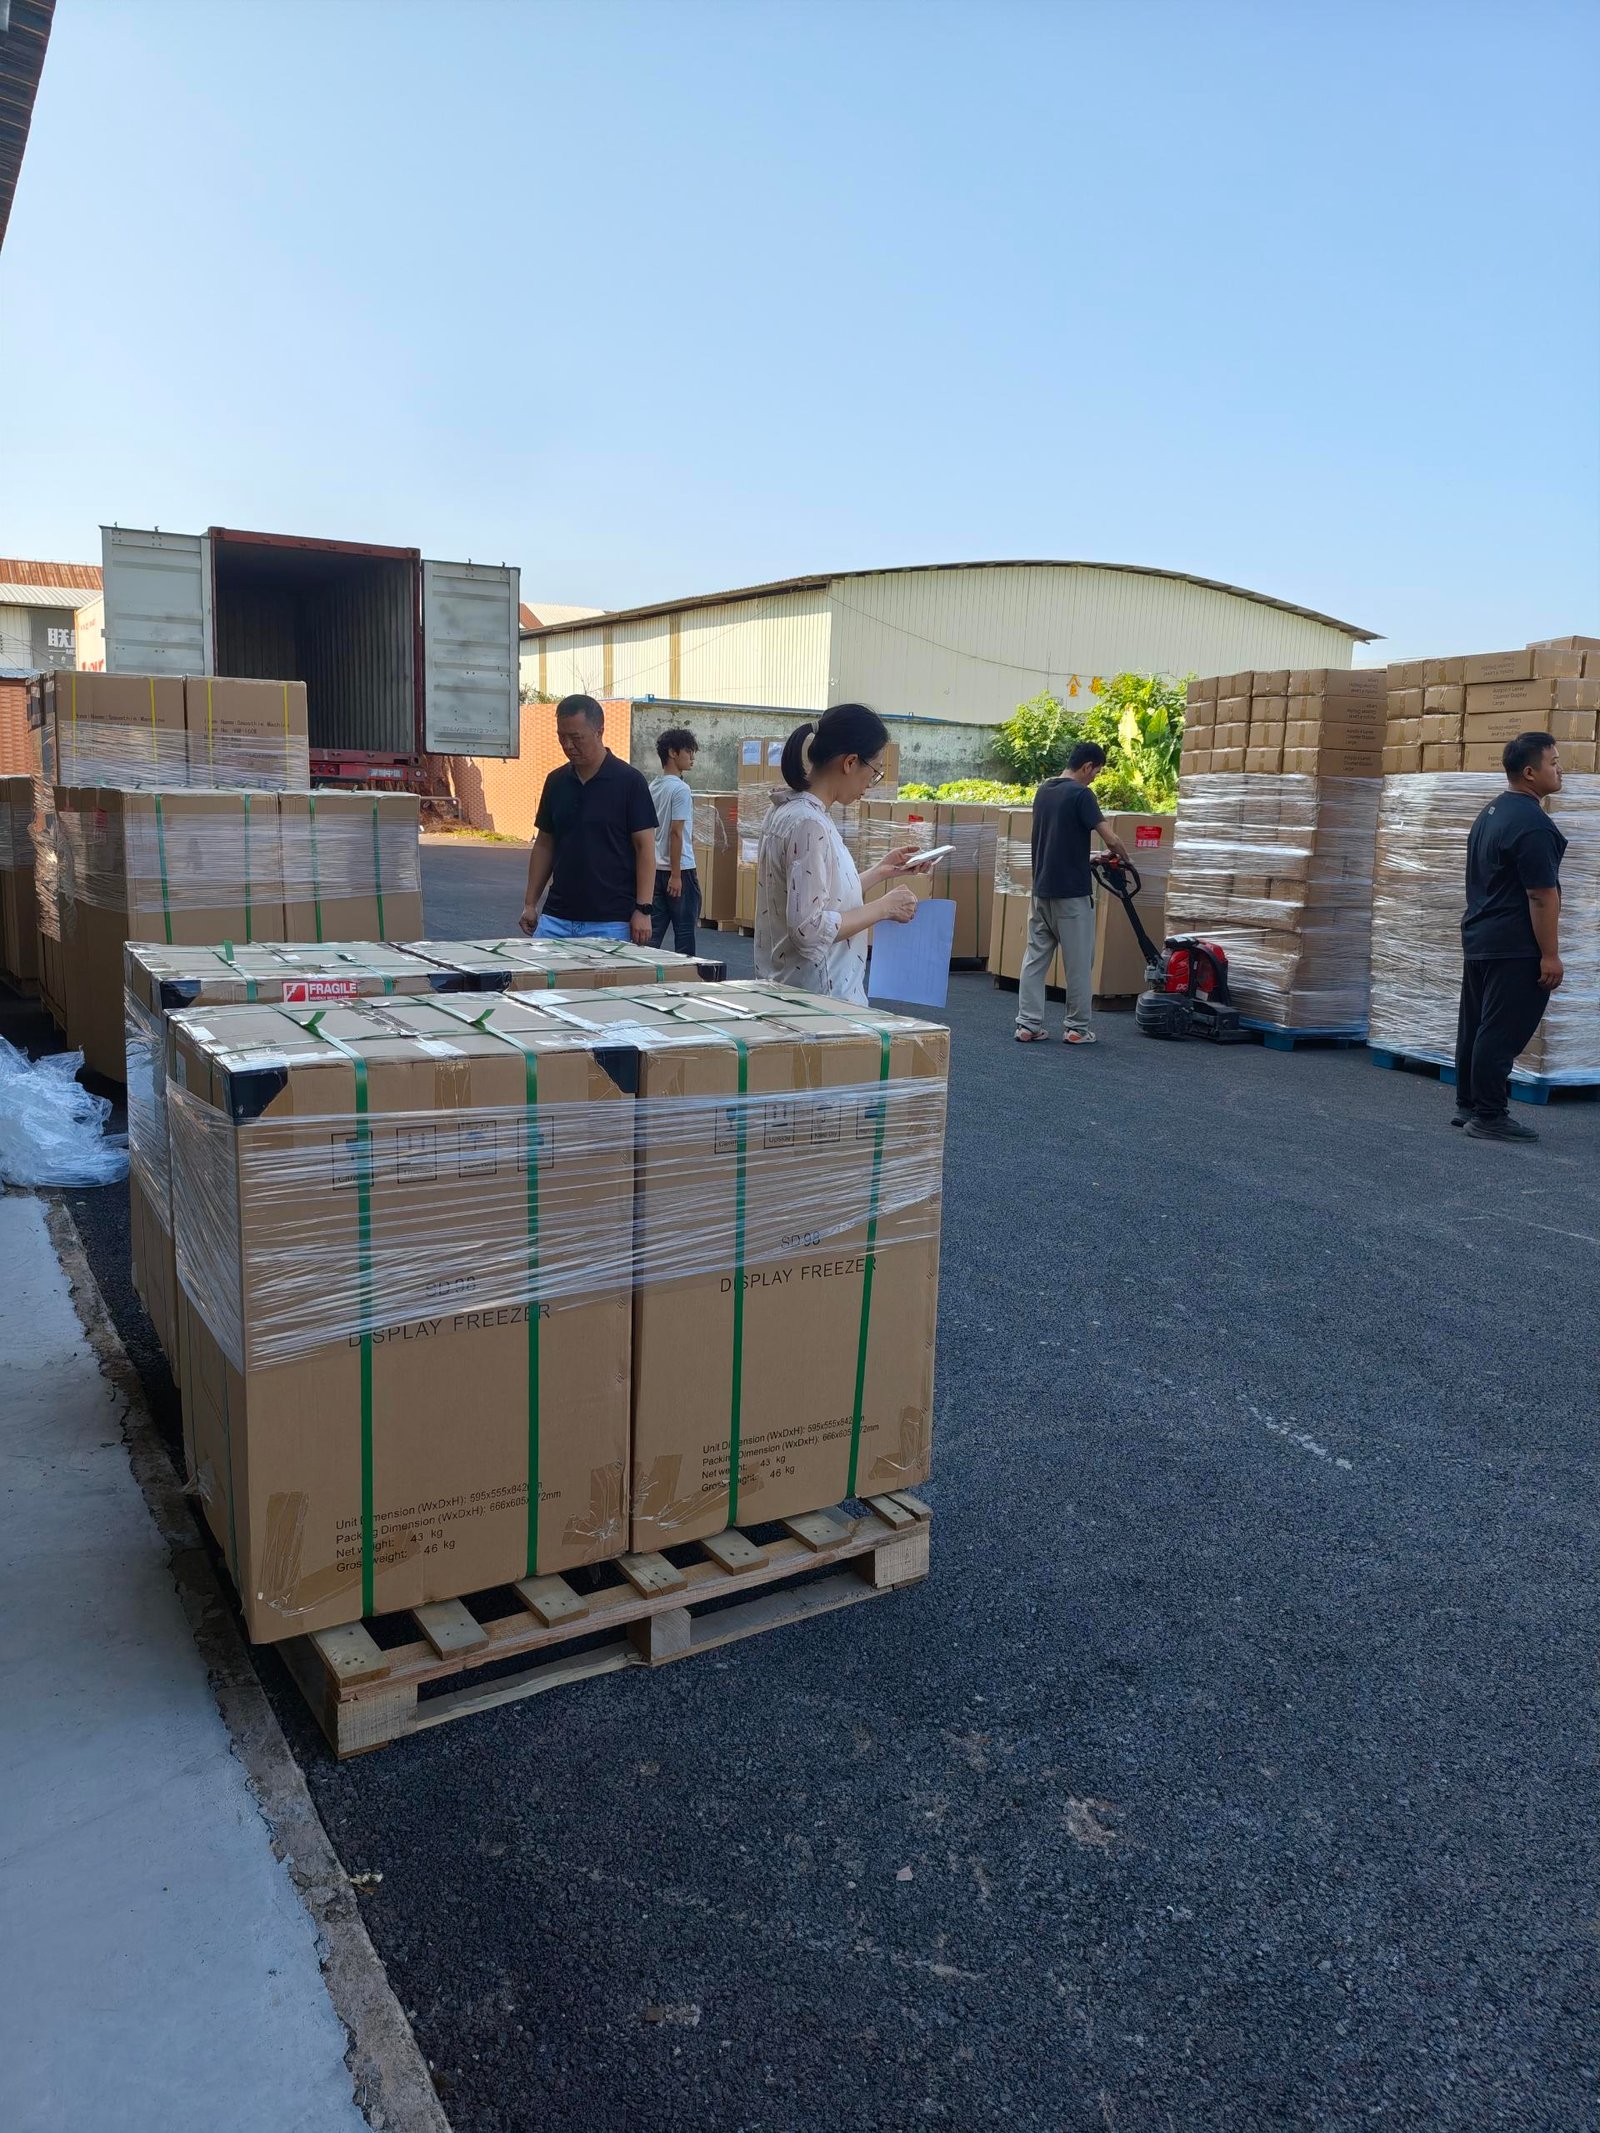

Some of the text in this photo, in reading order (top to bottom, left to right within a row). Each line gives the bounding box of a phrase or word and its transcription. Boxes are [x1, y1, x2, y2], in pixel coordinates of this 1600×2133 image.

[309, 982, 357, 995] FRAGILE
[349, 1319, 442, 1348] DSPLAY
[702, 1443, 720, 1454] Unit
[702, 1455, 734, 1467] Packin
[701, 1470, 717, 1480] Net
[760, 1459, 771, 1467] 43
[776, 1455, 786, 1464] kg
[701, 1480, 726, 1492] Gross
[770, 1469, 782, 1479] 46
[785, 1465, 795, 1475] kg
[336, 1518, 358, 1530] Unit
[417, 1496, 467, 1515] (WxDxH):
[336, 1529, 379, 1544] Packg
[381, 1517, 436, 1535] Dimension
[438, 1506, 486, 1525] (WxDxH):
[336, 1547, 355, 1558] Net
[410, 1533, 424, 1543] 43
[431, 1529, 443, 1539] kg
[336, 1560, 366, 1573] Gros
[424, 1544, 439, 1555] 46
[443, 1540, 456, 1550] kg
